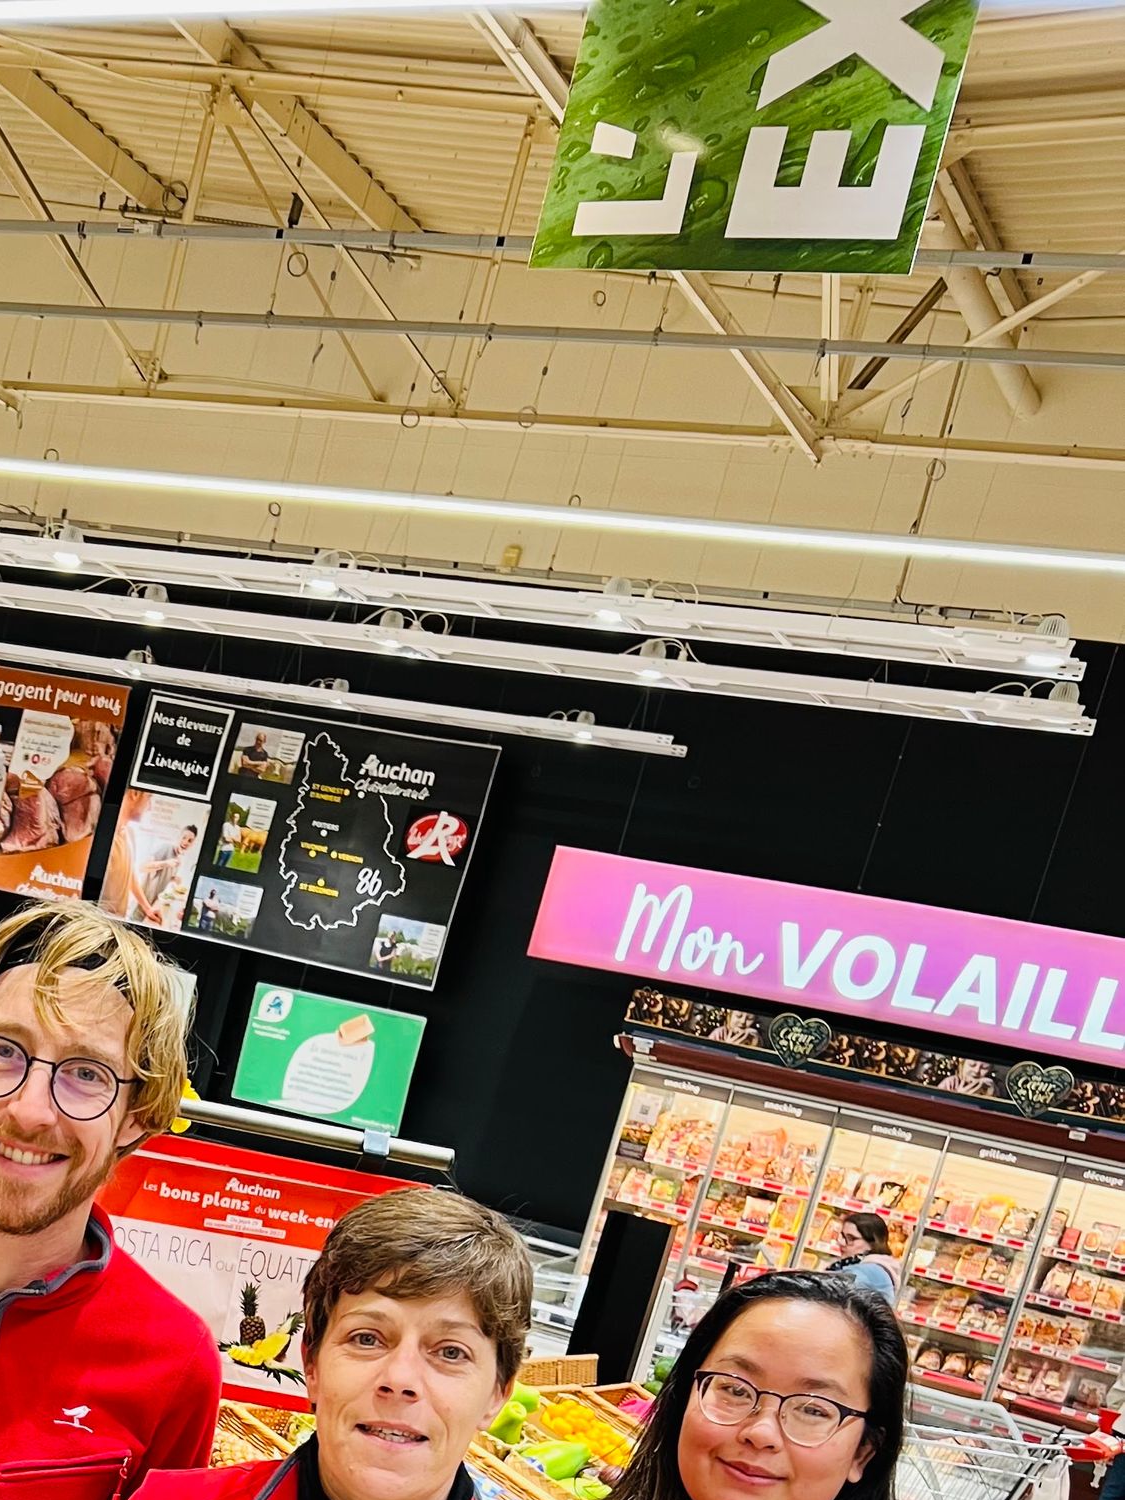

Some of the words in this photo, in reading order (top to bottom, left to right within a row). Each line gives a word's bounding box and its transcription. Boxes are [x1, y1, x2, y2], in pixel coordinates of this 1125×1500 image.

[572, 121, 698, 236] L'
[53, 687, 87, 711] pour
[89, 695, 122, 716] vous
[152, 711, 175, 728] Nos
[175, 716, 224, 735] éleveurs
[176, 733, 191, 747] de
[144, 746, 210, 777] Limousine
[358, 753, 435, 787] Auchan
[29, 864, 84, 891] Auchan
[355, 867, 383, 897] 86
[613, 883, 764, 977] Mon
[779, 921, 1125, 1051] VOLAILL
[763, 1100, 803, 1118] snacking
[871, 1124, 913, 1142] snacking
[979, 1148, 1017, 1164] grillade
[225, 1177, 281, 1200] Auchan
[1083, 1170, 1124, 1187] découpe
[143, 1180, 158, 1193] Les
[159, 1182, 200, 1203] bons
[202, 1191, 250, 1212] plans
[254, 1204, 267, 1215] du
[113, 1226, 161, 1261] OSTA
[167, 1235, 212, 1270] RICA
[215, 1258, 234, 1273] ou
